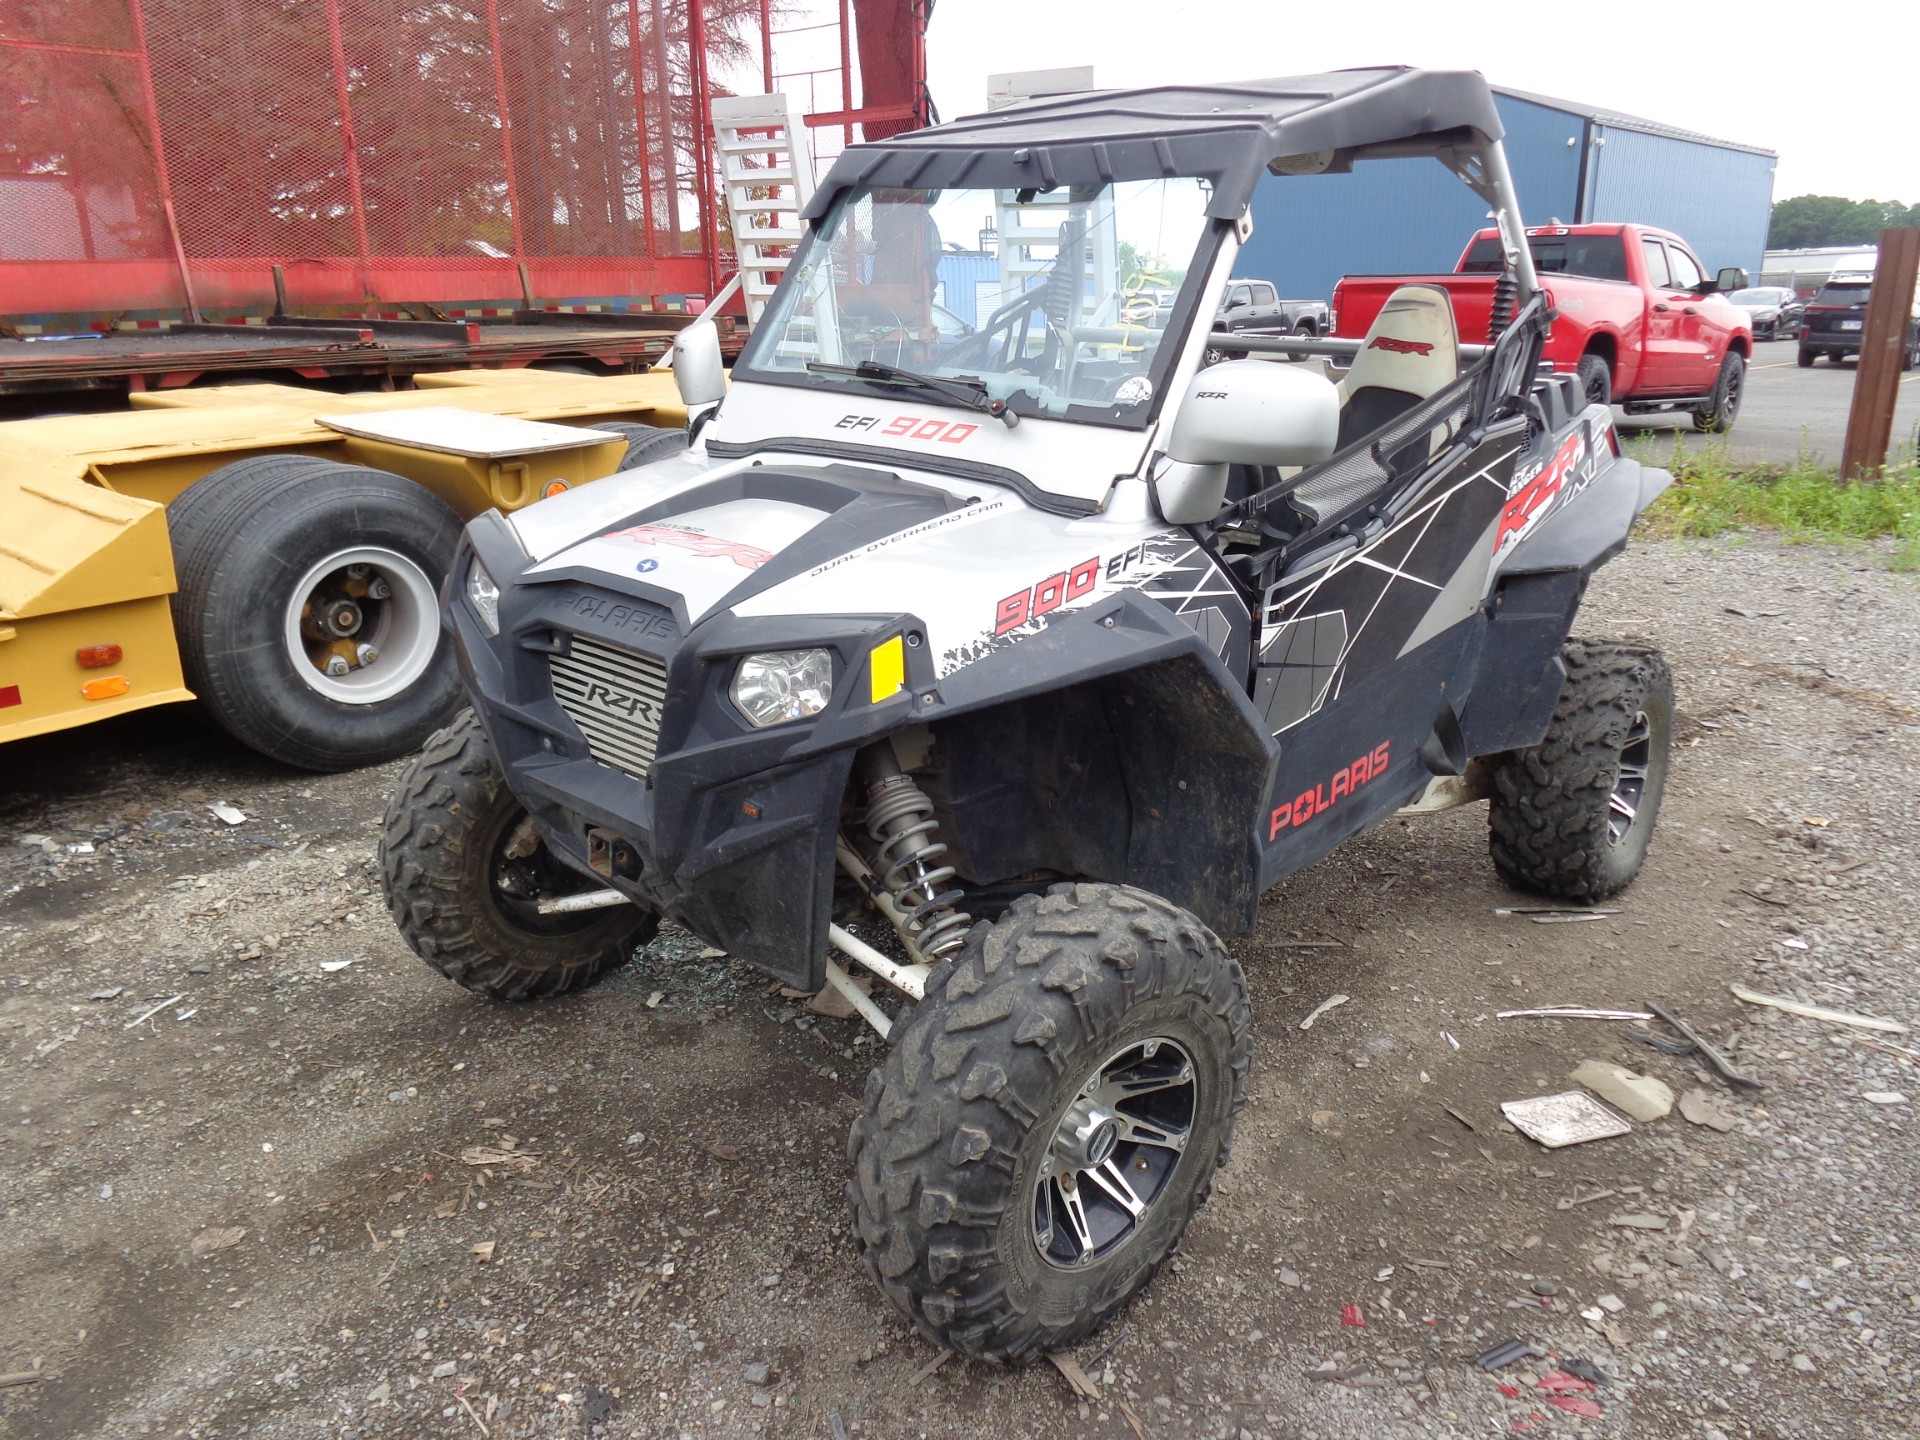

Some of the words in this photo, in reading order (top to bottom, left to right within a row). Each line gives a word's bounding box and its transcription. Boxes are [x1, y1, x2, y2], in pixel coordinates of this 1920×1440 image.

[1366, 336, 1435, 357] RZR
[1194, 391, 1229, 400] RZR
[834, 414, 881, 432] EFI
[880, 416, 981, 444] 900
[811, 553, 862, 578] DUAL
[867, 513, 962, 553] OVERHEAD
[966, 500, 1004, 518] CAM
[995, 555, 1100, 637] 900
[1106, 541, 1146, 581] EFI
[554, 590, 677, 638] POLARIS
[587, 682, 653, 724] RZR
[1269, 739, 1391, 843] POLARIS
